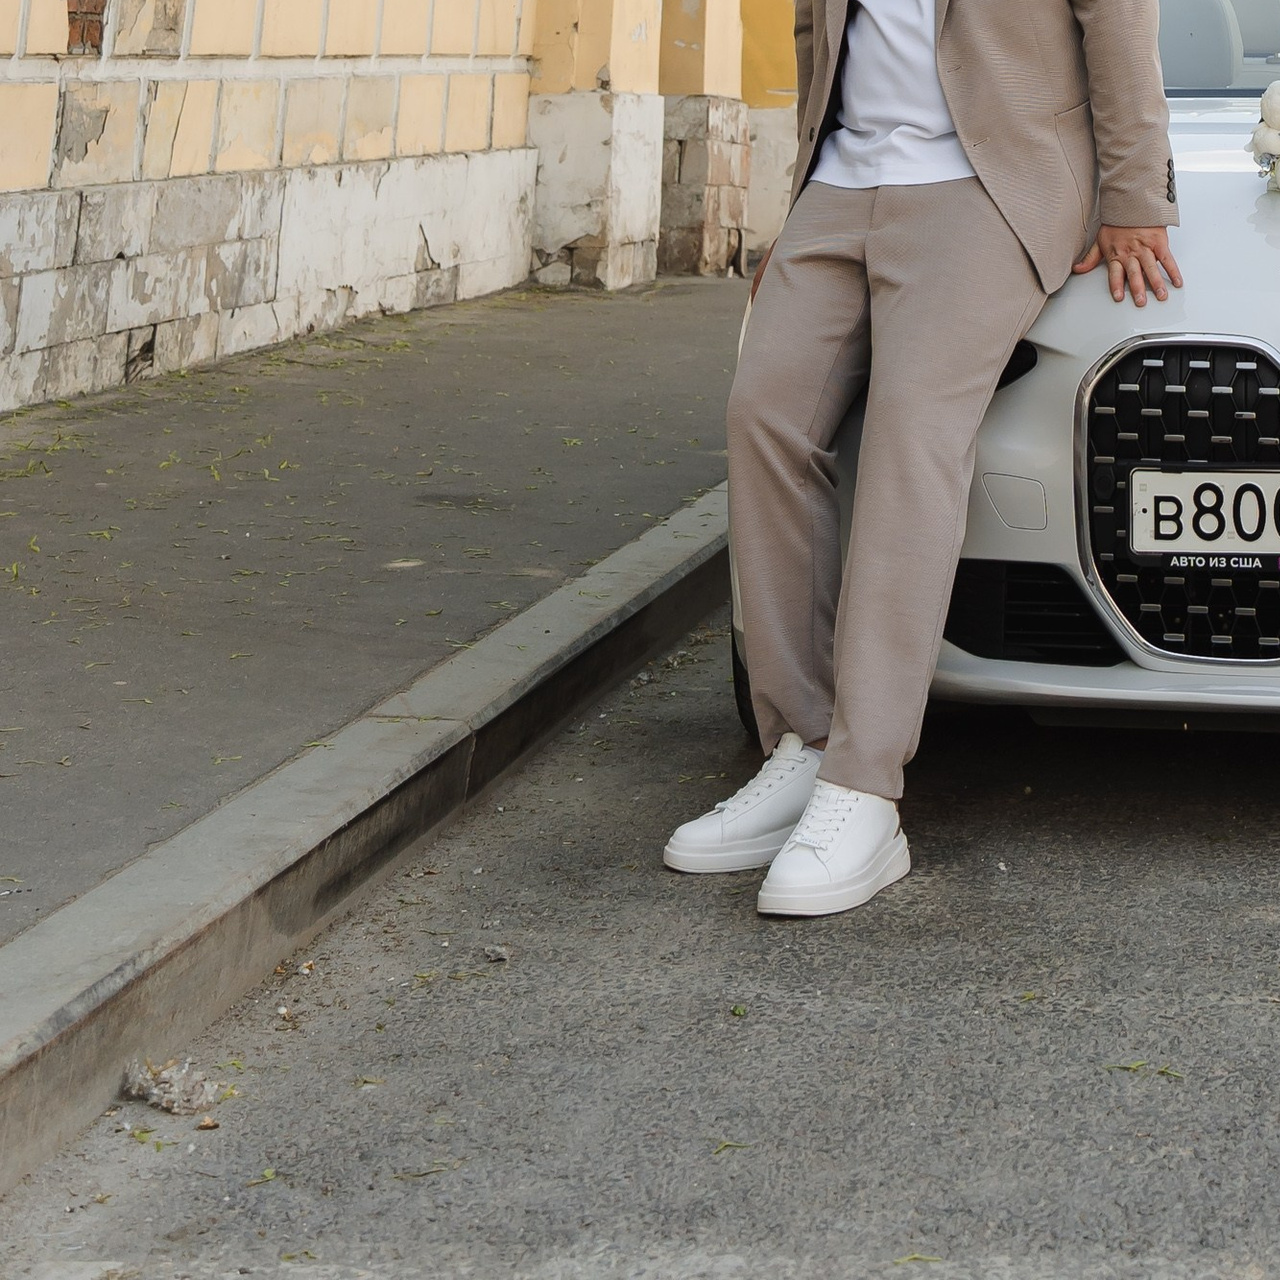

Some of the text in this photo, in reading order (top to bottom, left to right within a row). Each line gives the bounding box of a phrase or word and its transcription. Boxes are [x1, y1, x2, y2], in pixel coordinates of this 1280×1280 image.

[1170, 555, 1263, 568] АВТО ИЗ США
